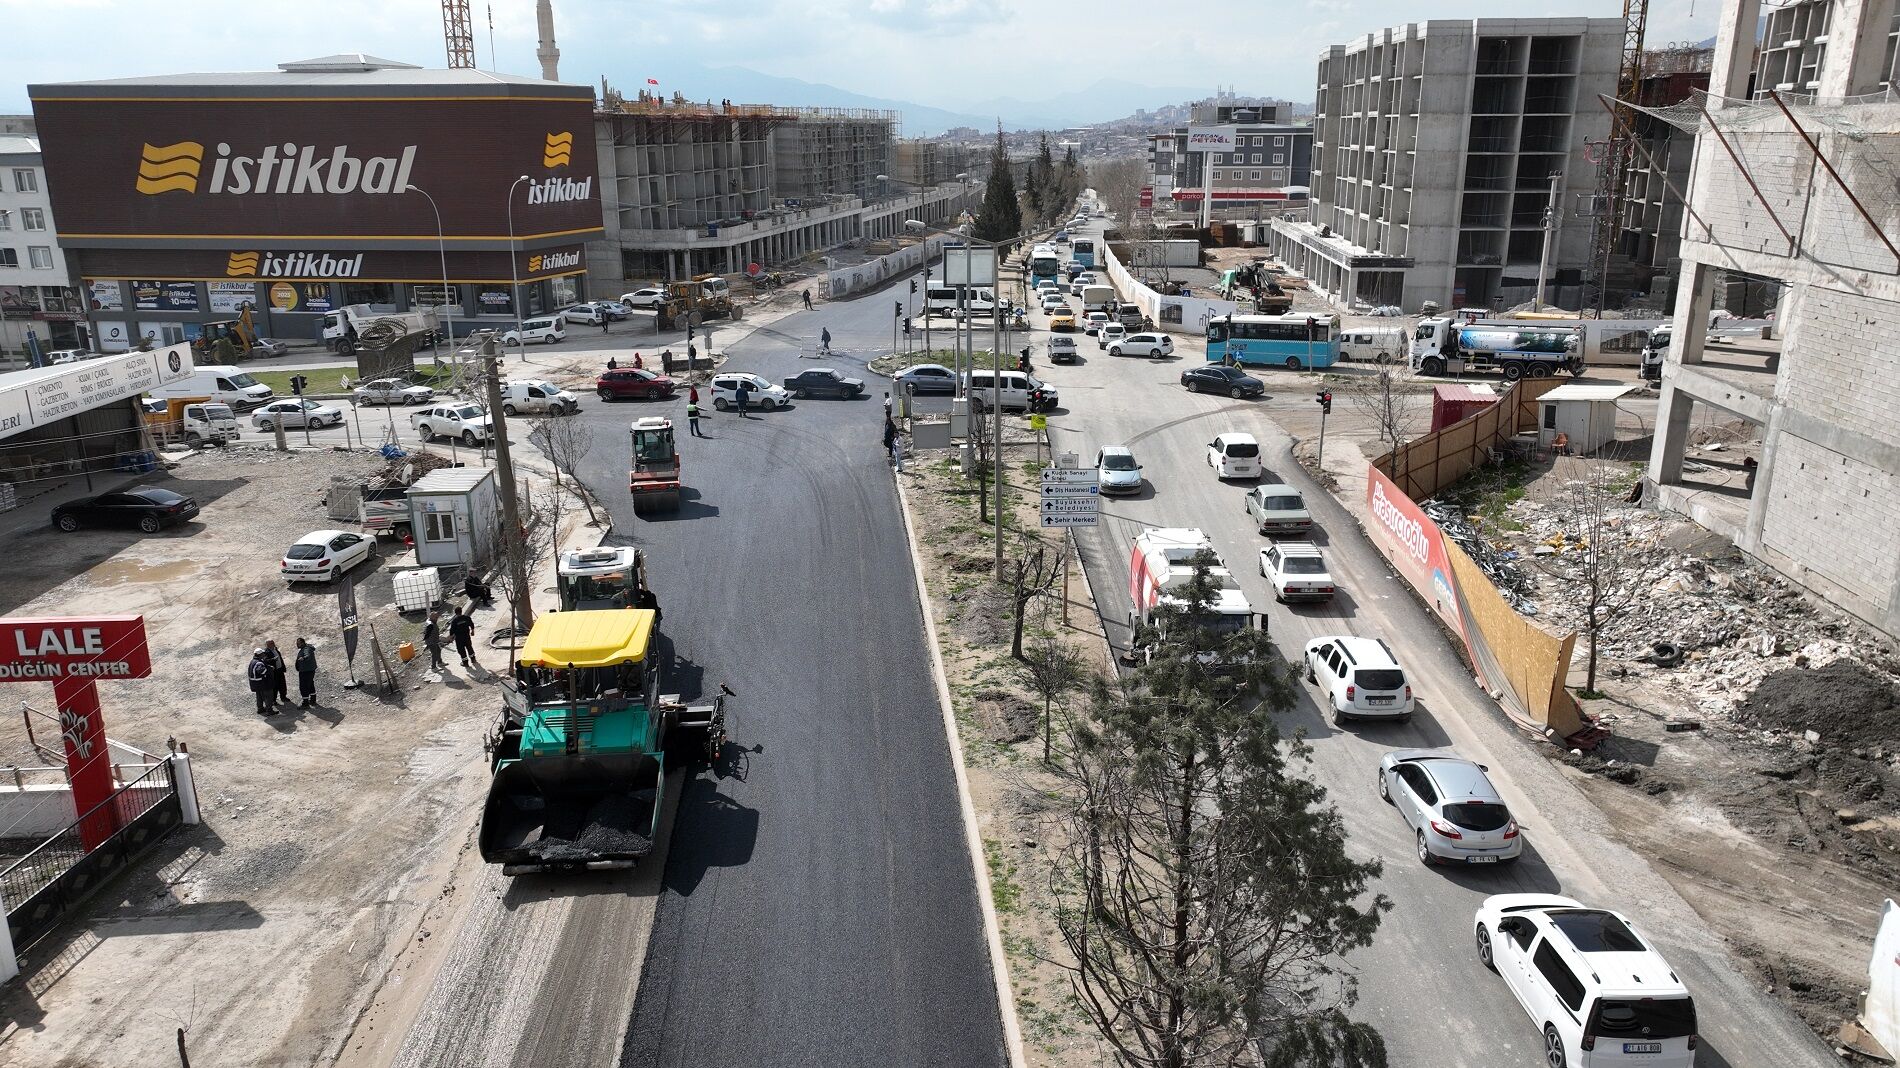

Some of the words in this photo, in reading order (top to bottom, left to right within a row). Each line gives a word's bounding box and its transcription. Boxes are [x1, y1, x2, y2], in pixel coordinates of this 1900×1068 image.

[209, 143, 418, 194] istikbal
[528, 176, 592, 205] istikbal
[261, 252, 363, 277] istikbal
[542, 251, 580, 270] istikbal
[220, 282, 247, 290] istikbal
[40, 391, 69, 407] GAZBETON
[61, 401, 79, 414] BETON
[14, 627, 104, 657] LALE
[0, 660, 62, 678] DÜĞÜN
[67, 661, 131, 676] CENTER
